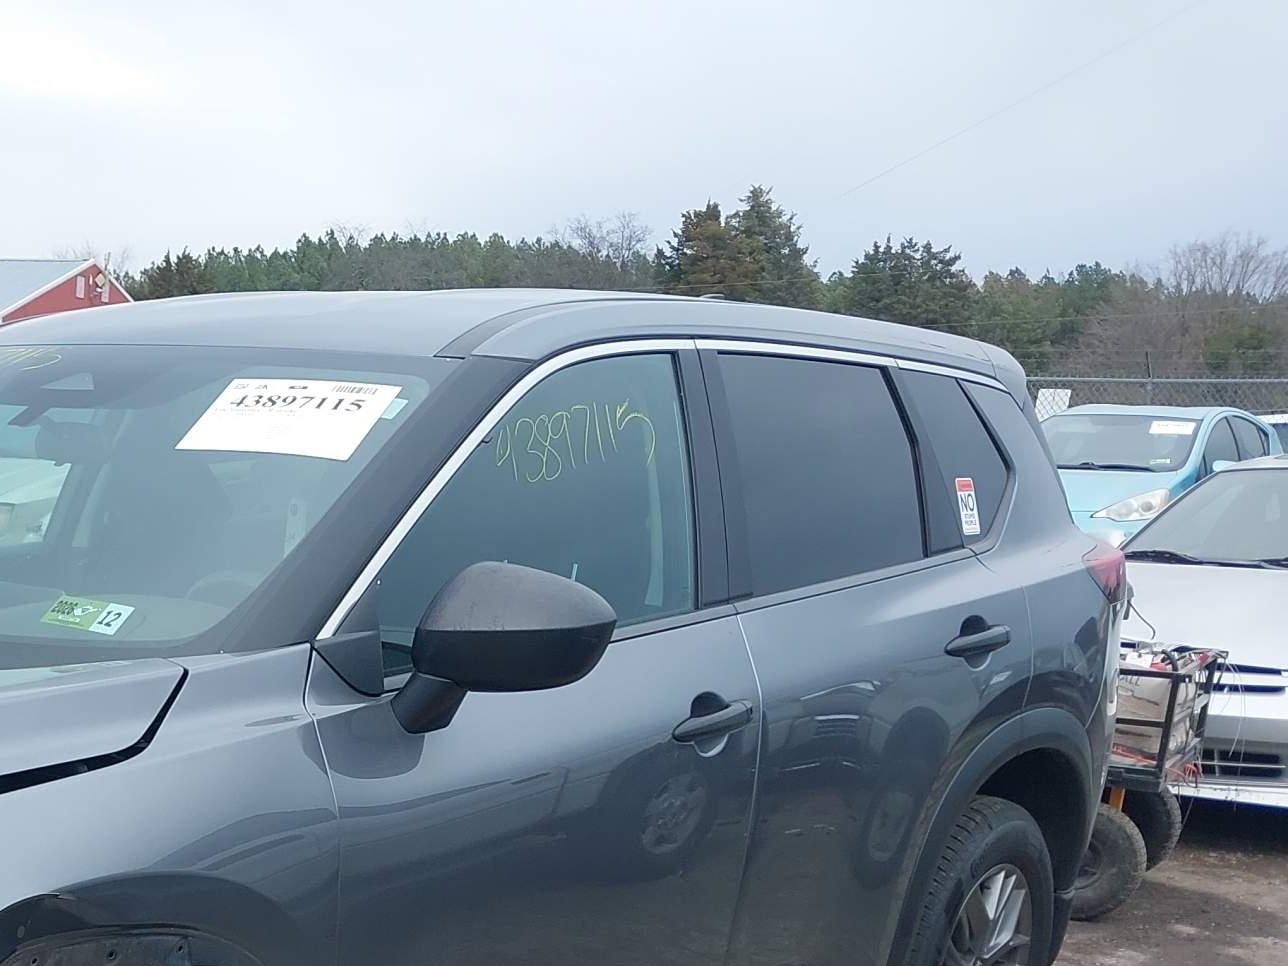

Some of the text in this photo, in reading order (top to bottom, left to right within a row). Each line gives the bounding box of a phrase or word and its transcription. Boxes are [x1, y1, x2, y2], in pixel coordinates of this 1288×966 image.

[229, 393, 367, 413] 43897115
[496, 398, 656, 483] 43897115
[959, 492, 975, 513] NO
[96, 609, 123, 628] 12
